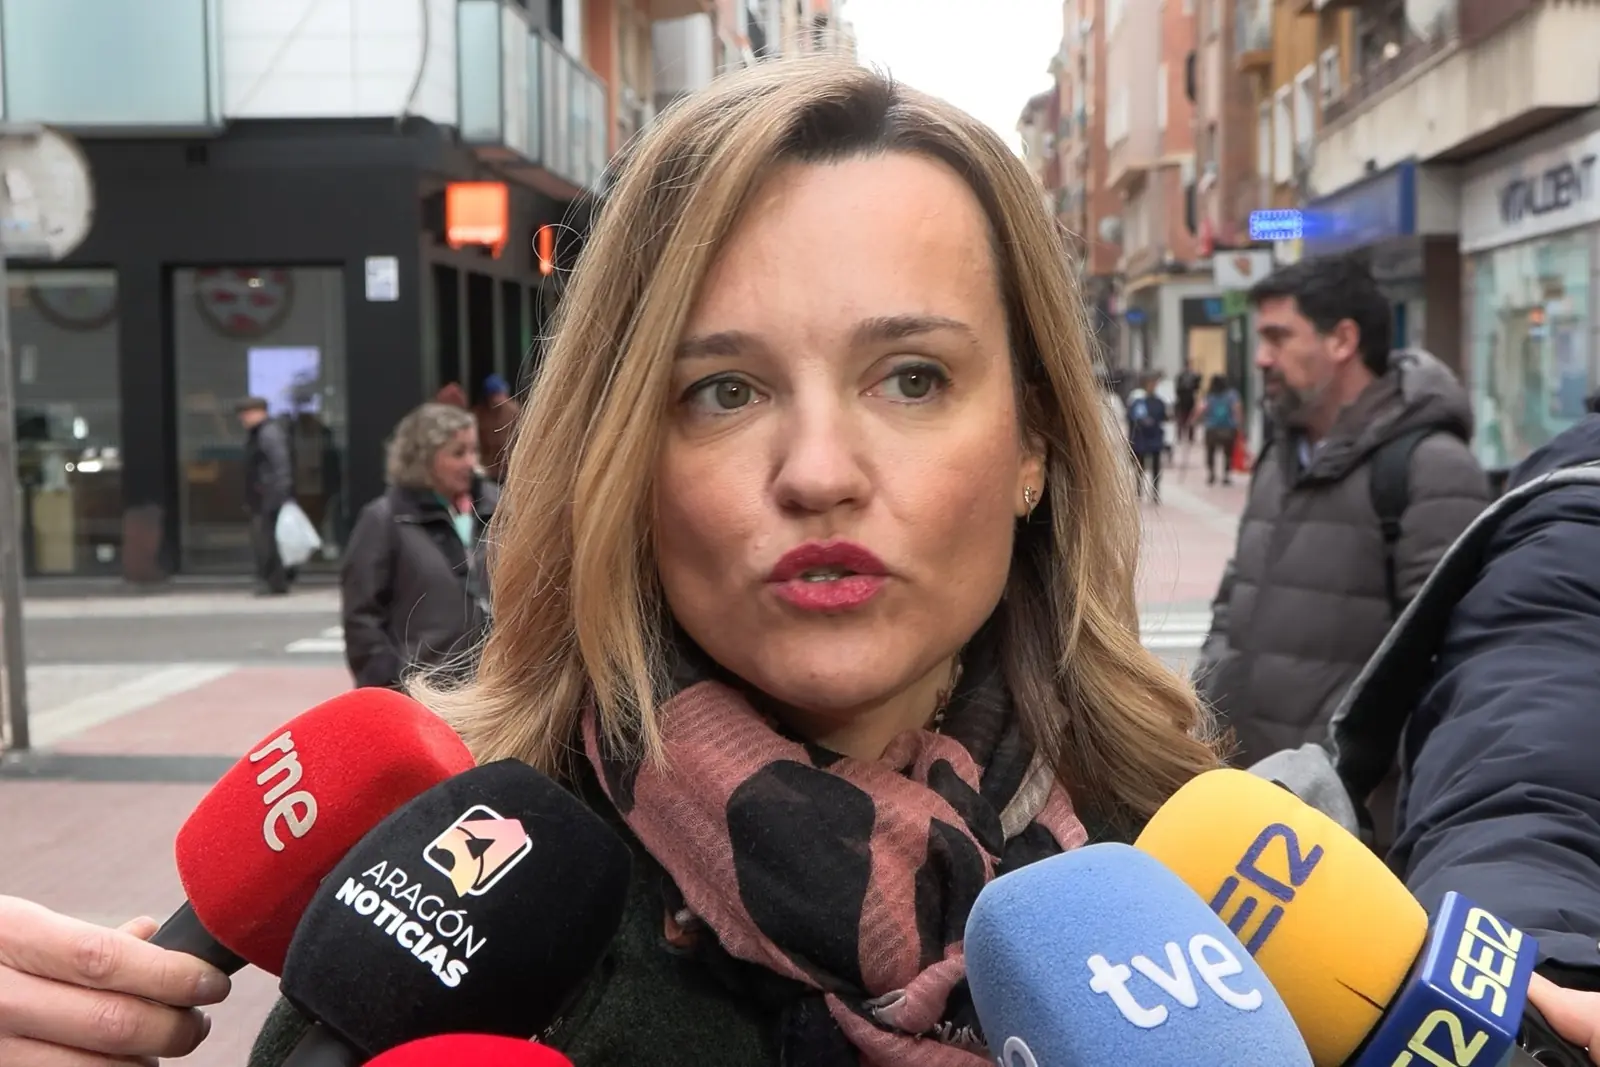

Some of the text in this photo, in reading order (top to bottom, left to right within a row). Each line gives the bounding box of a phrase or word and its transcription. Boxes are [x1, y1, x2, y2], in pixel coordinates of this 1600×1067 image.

[249, 730, 318, 852] rne
[335, 877, 469, 988] NOTICIAS
[361, 860, 487, 959] ARAGÓN
[1450, 907, 1523, 1018] SER
[1086, 933, 1264, 1029] tve
